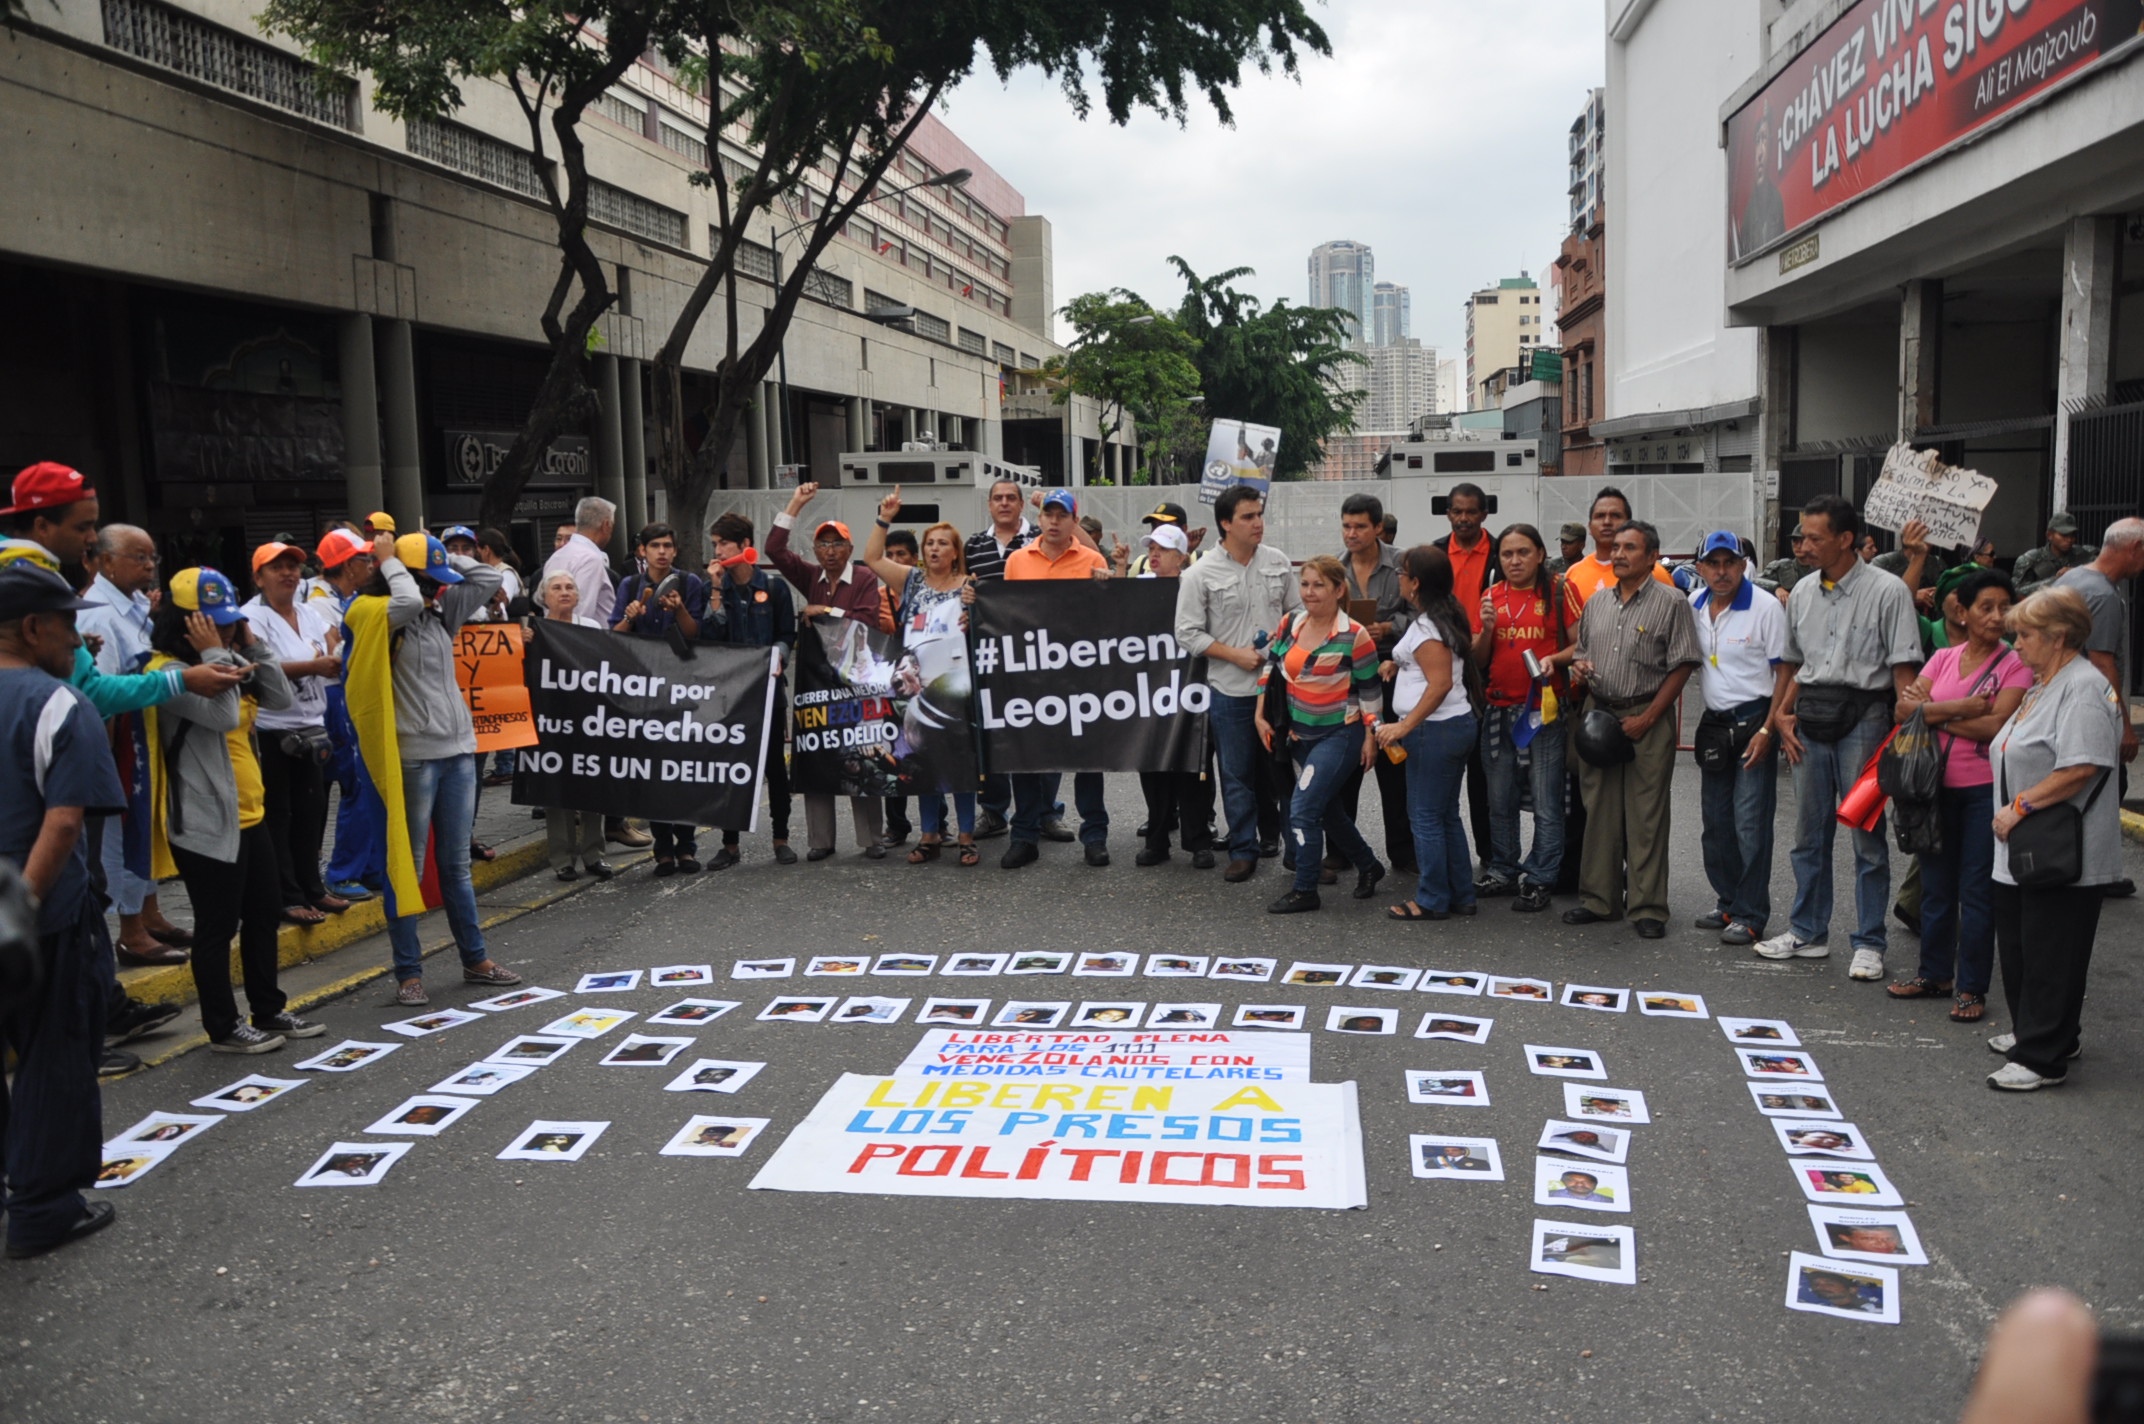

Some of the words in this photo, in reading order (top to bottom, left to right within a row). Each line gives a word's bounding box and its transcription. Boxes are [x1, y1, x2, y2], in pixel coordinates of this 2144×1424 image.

[1974, 66, 1995, 110] Ali
[1997, 56, 2012, 97] El
[2014, 6, 2097, 86] Majzoub
[1777, 25, 1867, 170] ¡CHÁVEZ
[1811, 124, 1840, 188] LA
[1845, 34, 1934, 158] LUCHA
[1943, 0, 2028, 69] SIG
[1496, 626, 1545, 641] SPAIN
[462, 660, 480, 685] Y
[541, 658, 665, 697] Luchar
[670, 684, 716, 705] por
[831, 687, 853, 701] UNA
[852, 682, 888, 698] MEJOR
[979, 668, 1211, 737] Leopoldo
[538, 714, 573, 735] tus
[582, 705, 747, 745] derechos
[794, 697, 893, 729] VENEZUELA
[796, 732, 820, 753] NO
[822, 729, 841, 749] ES
[843, 721, 899, 747] DELITO
[518, 751, 563, 774] NO
[572, 754, 601, 777] ES
[609, 756, 651, 780] UN
[661, 759, 752, 785] DELITO
[939, 1043, 1015, 1054] PARA
[1028, 1043, 1088, 1053] LOS
[949, 1032, 1111, 1044] LIBERTAD
[1133, 1033, 1231, 1043] PLENA
[922, 1064, 1067, 1076] MEDIDAS
[1079, 1065, 1284, 1080] CAUTELARES
[937, 1051, 1170, 1066] VENEZOLANOS
[1190, 1055, 1255, 1066] CON
[863, 1079, 1175, 1112] LIBEREN
[1209, 1085, 1284, 1112] A
[843, 1109, 973, 1135] LOS
[998, 1111, 1302, 1144] PRESOS
[845, 1139, 1308, 1191] POLÍTICOS
